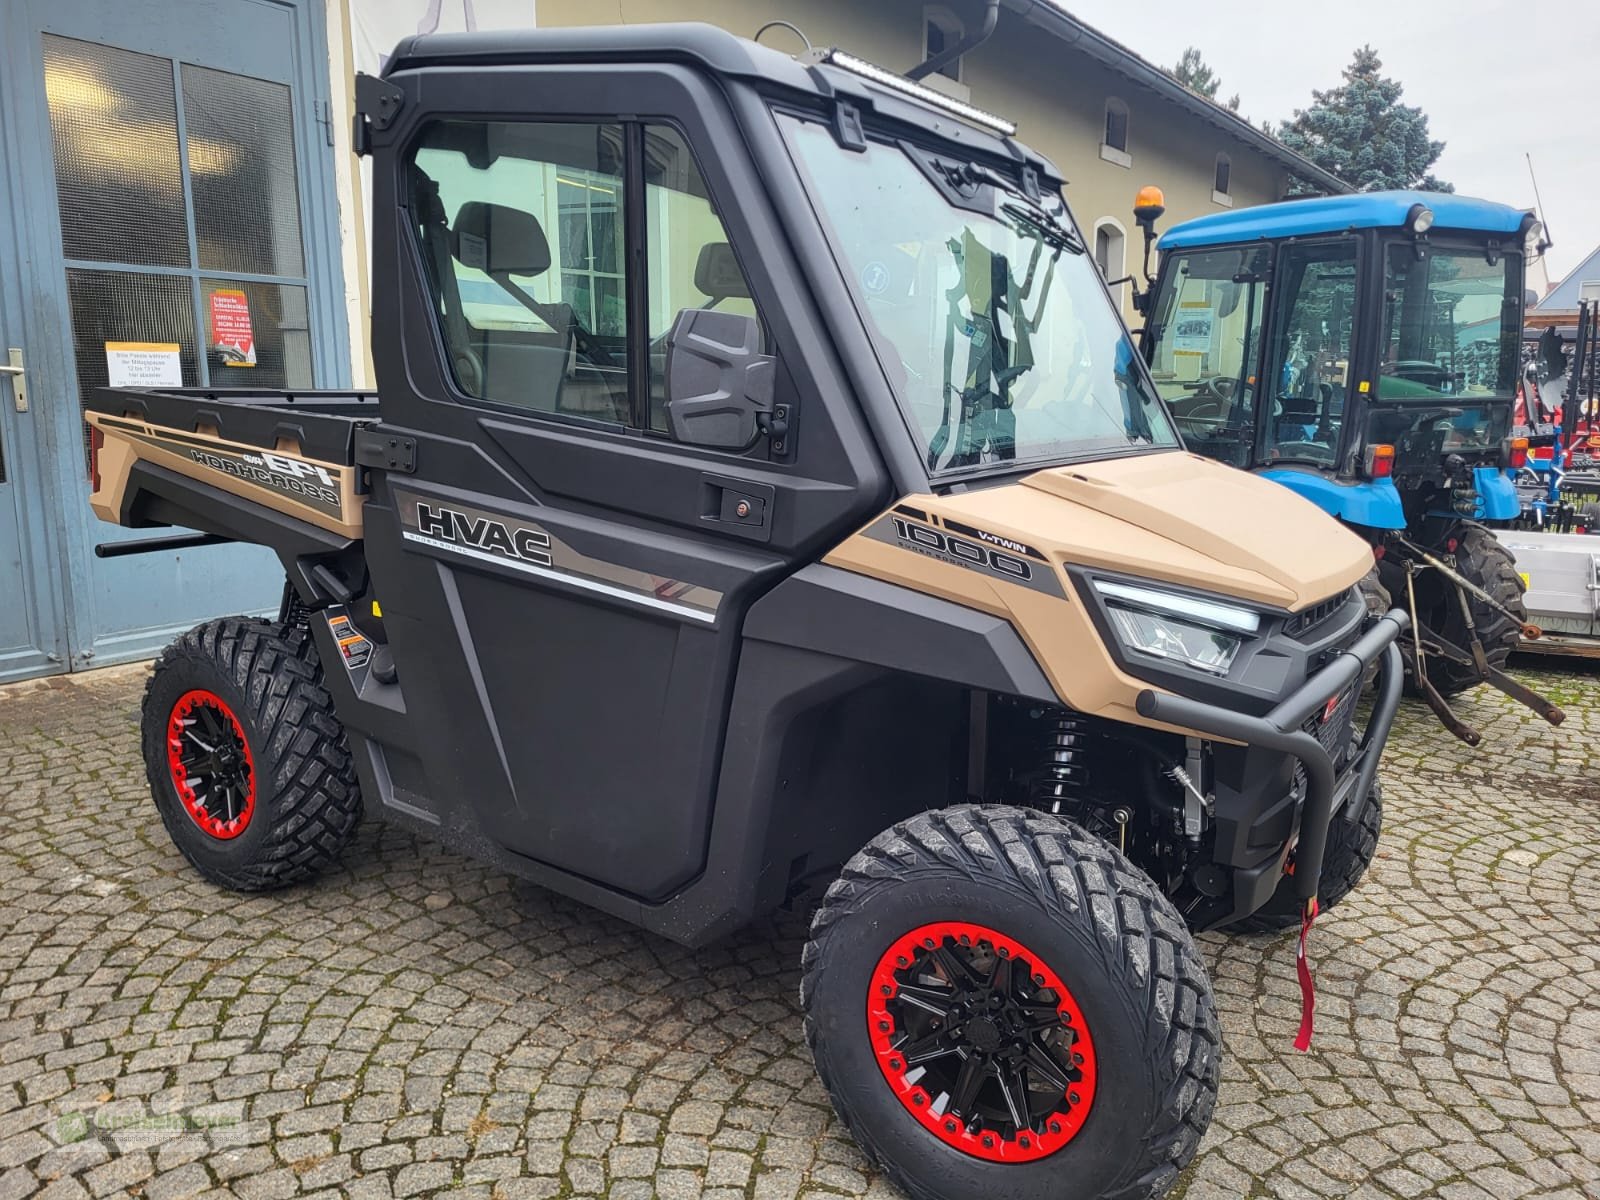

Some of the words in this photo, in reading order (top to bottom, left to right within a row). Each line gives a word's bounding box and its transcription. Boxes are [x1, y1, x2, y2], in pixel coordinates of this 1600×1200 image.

[190, 449, 341, 507] WORKCROSS
[261, 453, 334, 487] EFI
[416, 502, 552, 567] HVAC
[892, 516, 1033, 582] 1000
[977, 530, 1027, 554] V-TWIN
